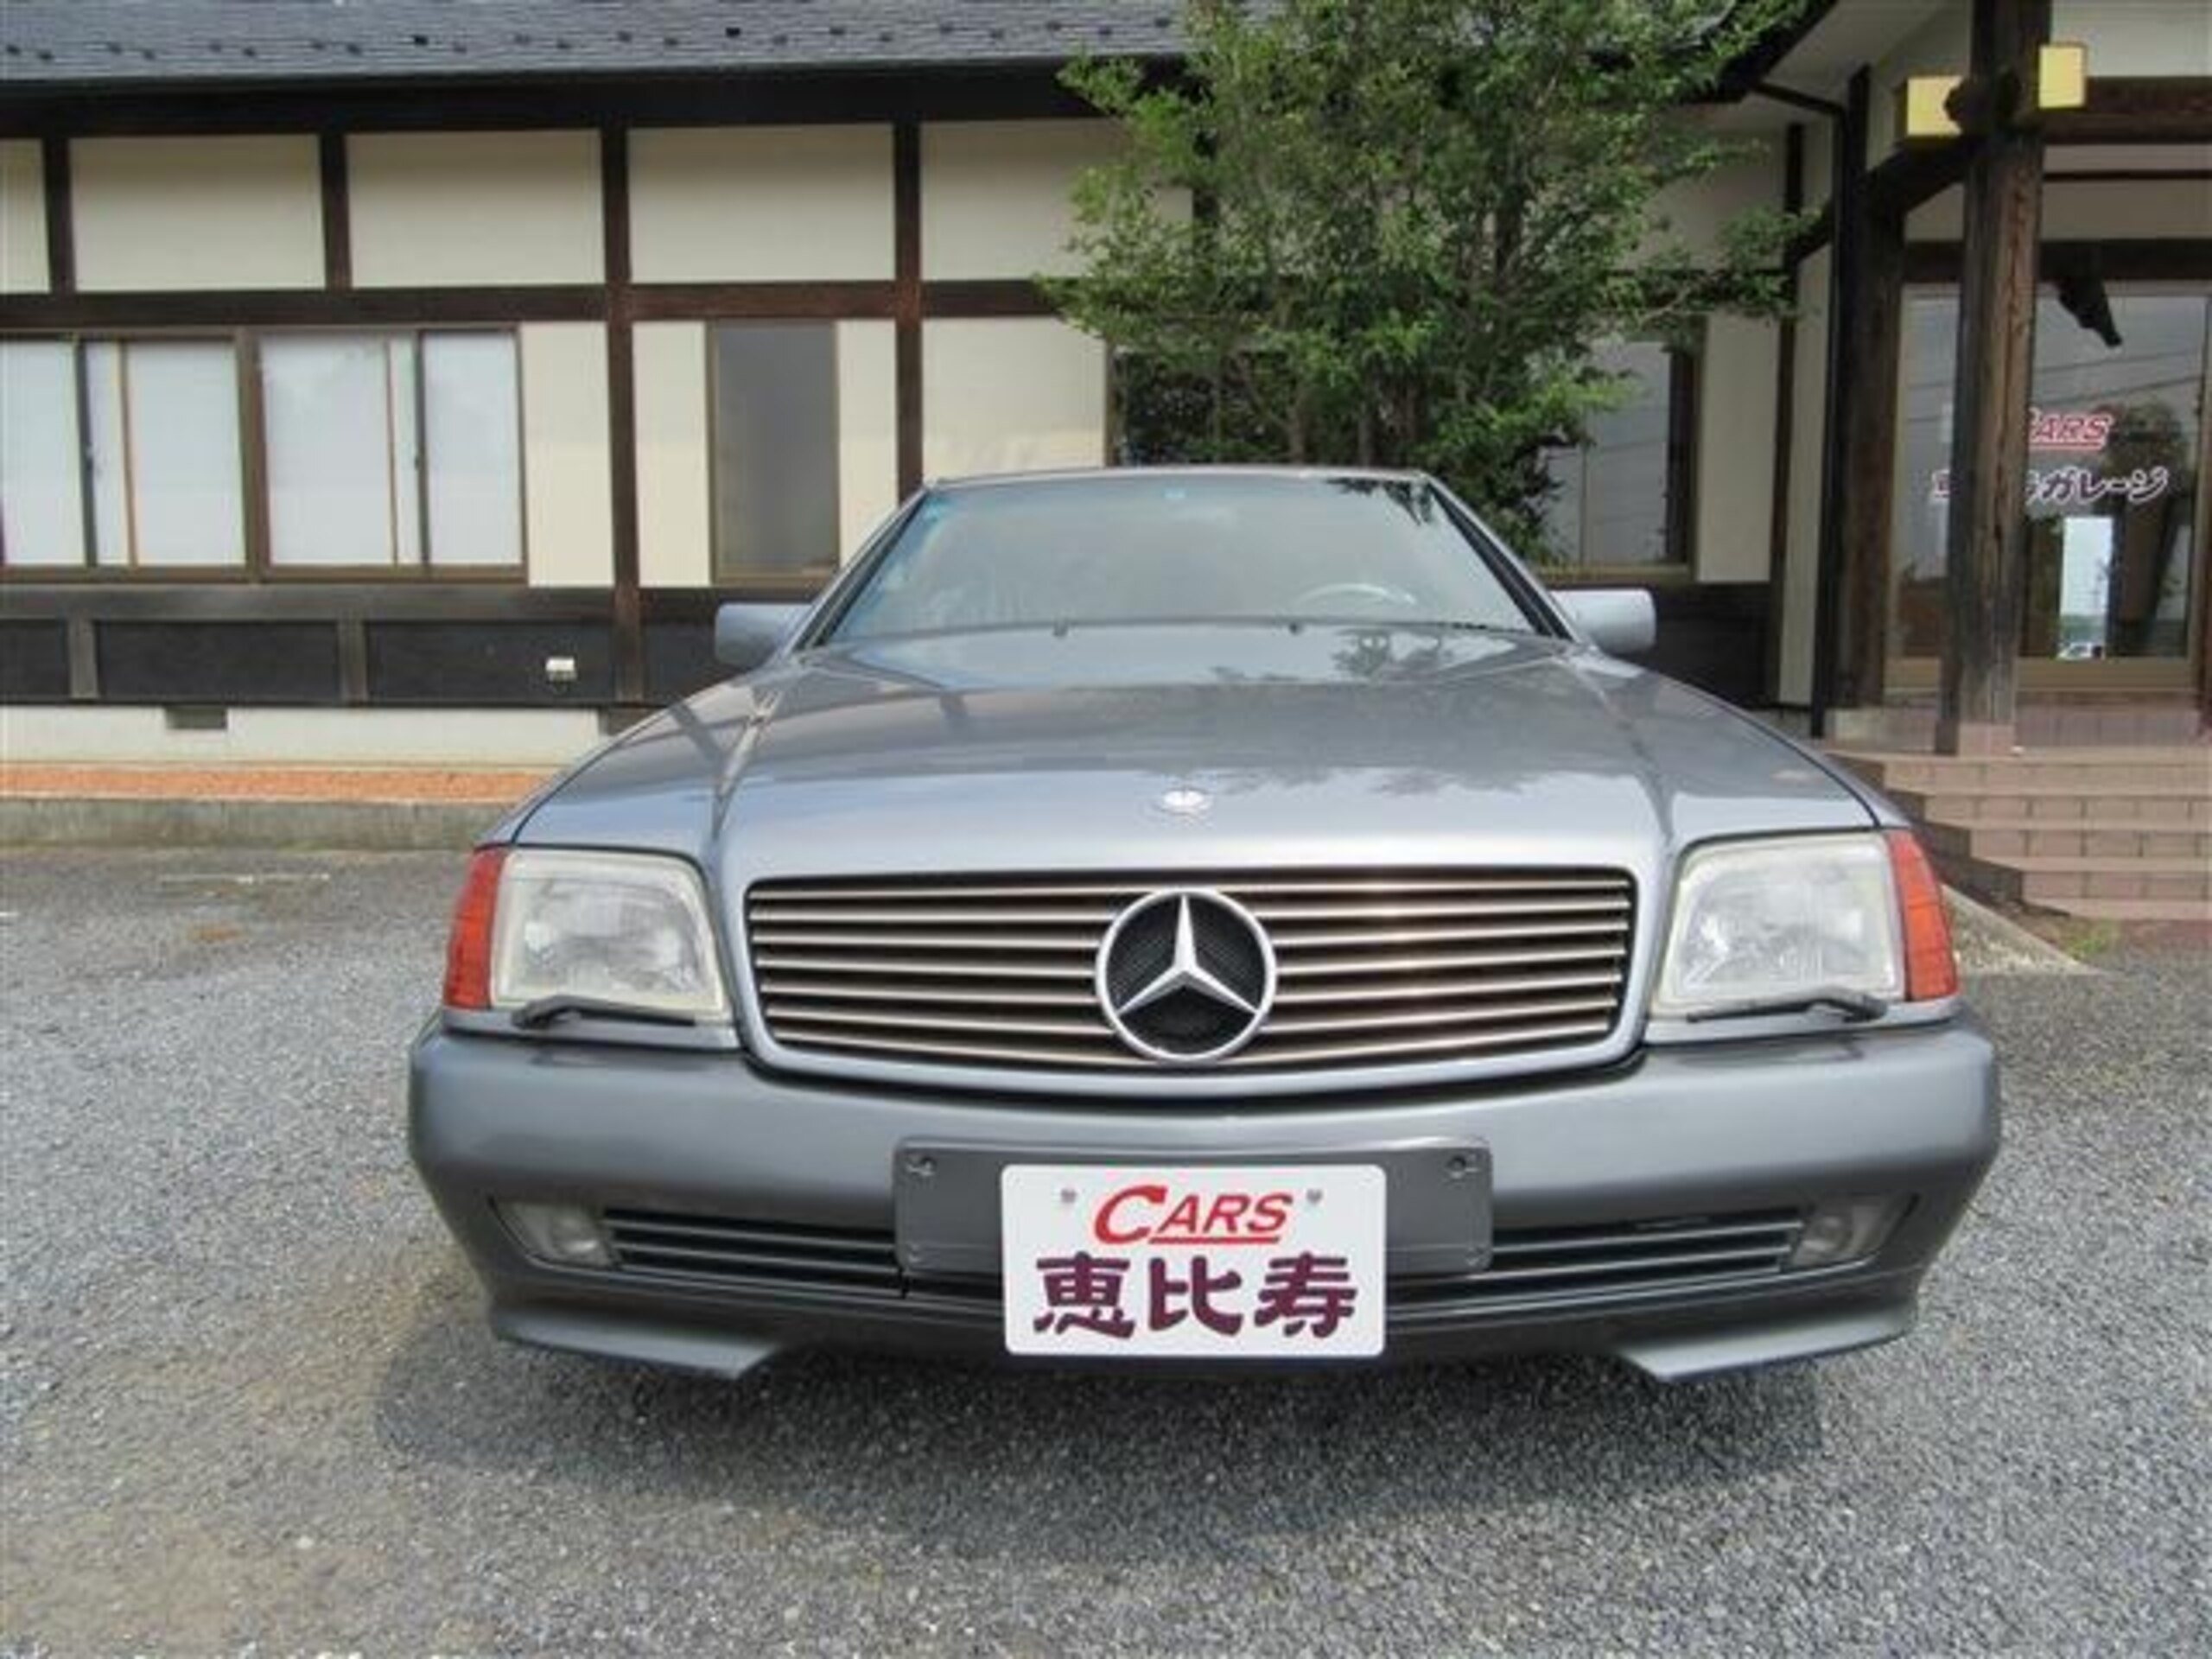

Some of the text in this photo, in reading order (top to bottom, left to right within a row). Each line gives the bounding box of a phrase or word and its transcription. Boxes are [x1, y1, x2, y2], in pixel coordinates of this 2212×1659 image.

[2029, 406, 2114, 452] ARS
[1093, 1184, 1293, 1244] CARS
[1033, 1251, 1358, 1338] 恵比寿
